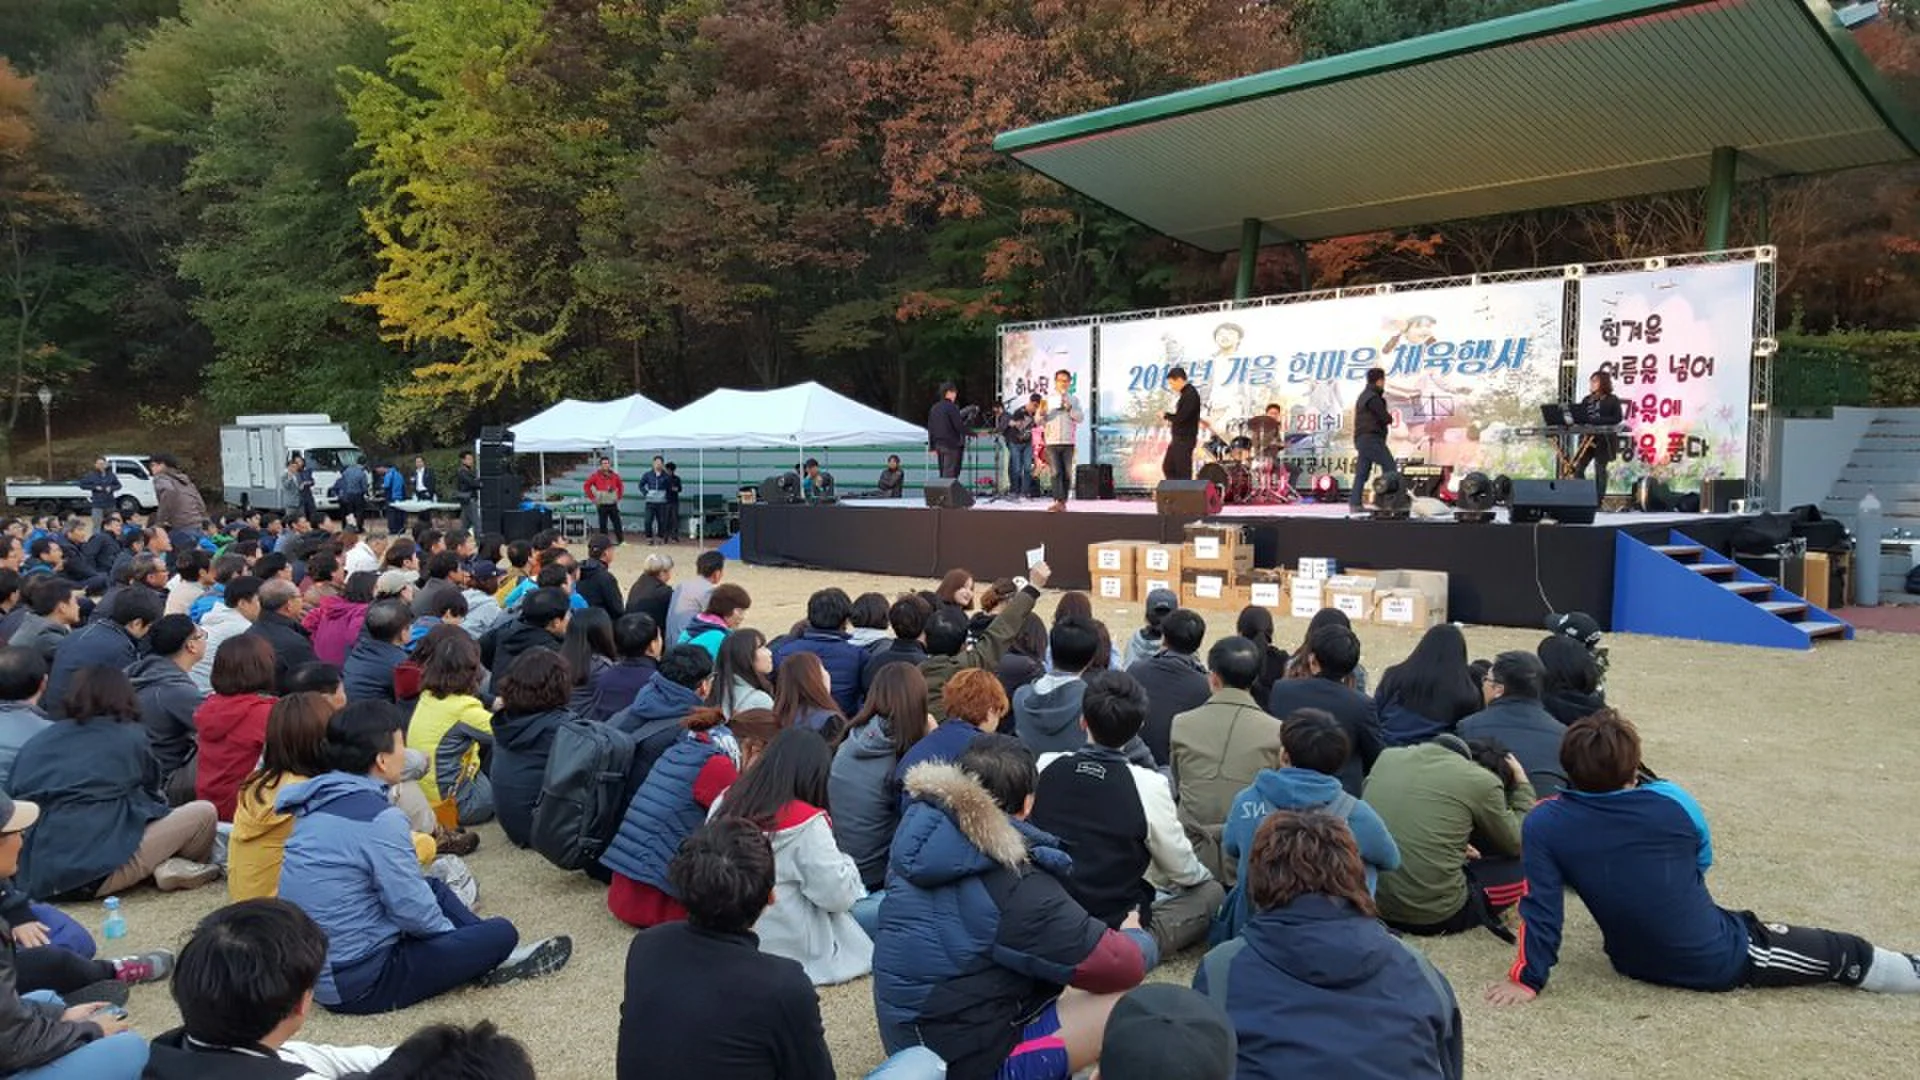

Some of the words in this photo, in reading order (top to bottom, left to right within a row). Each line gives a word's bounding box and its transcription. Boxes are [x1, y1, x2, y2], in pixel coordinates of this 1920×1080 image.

[1600, 314, 1662, 347] 힘겨운
[1128, 360, 1213, 391] 201년
[1221, 355, 1278, 386] 가을
[1288, 347, 1377, 383] 한마음
[1387, 337, 1529, 377] 체육행사
[1600, 354, 1657, 384] 여름을
[1669, 354, 1714, 382] 넘어
[1619, 394, 1682, 424] 가을에
[1616, 434, 1656, 464] 망을
[1667, 432, 1709, 462] 품다
